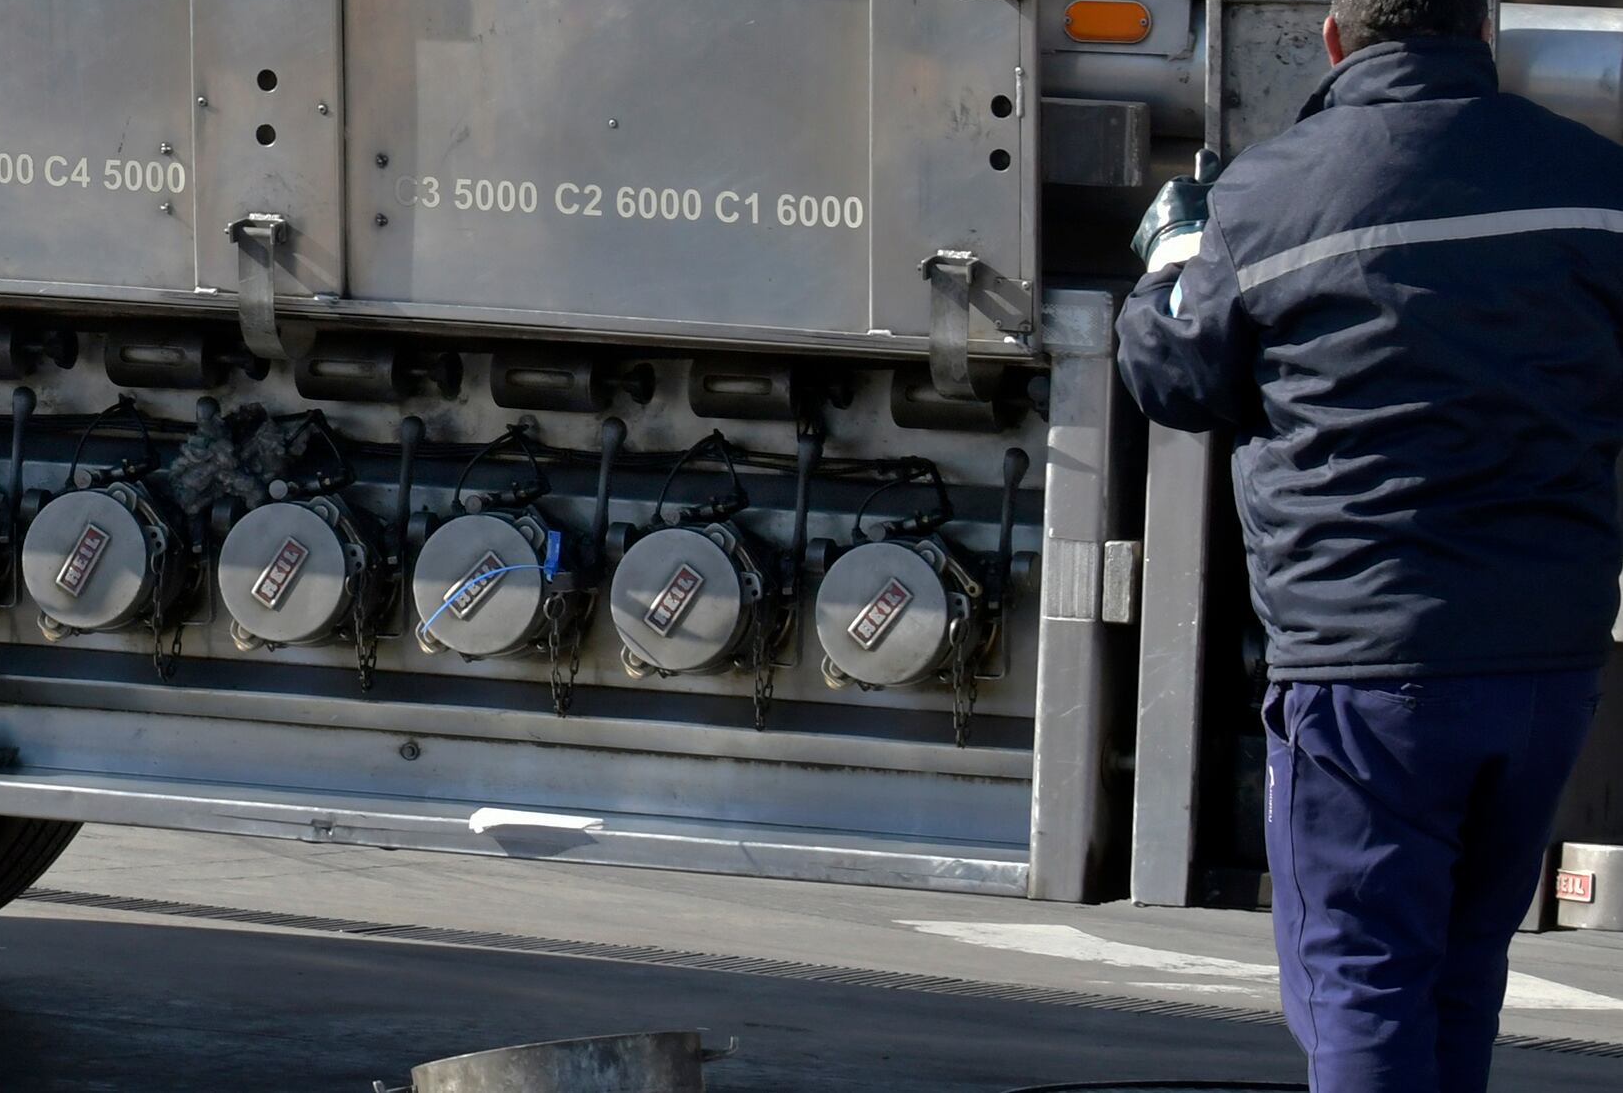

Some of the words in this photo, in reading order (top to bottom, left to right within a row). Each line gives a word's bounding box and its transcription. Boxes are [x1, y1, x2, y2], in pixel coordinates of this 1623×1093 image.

[44, 154, 91, 188] C4
[103, 158, 187, 194] 5000
[394, 174, 441, 209] C3
[454, 178, 538, 213] 5000
[554, 182, 603, 217] C2
[616, 186, 703, 221] 6000
[715, 190, 761, 225] C1
[777, 193, 864, 229] 6000
[64, 536, 101, 586] HEIL
[260, 549, 300, 599] HEIL
[653, 577, 695, 626] HEIL
[857, 592, 903, 639] HEIL
